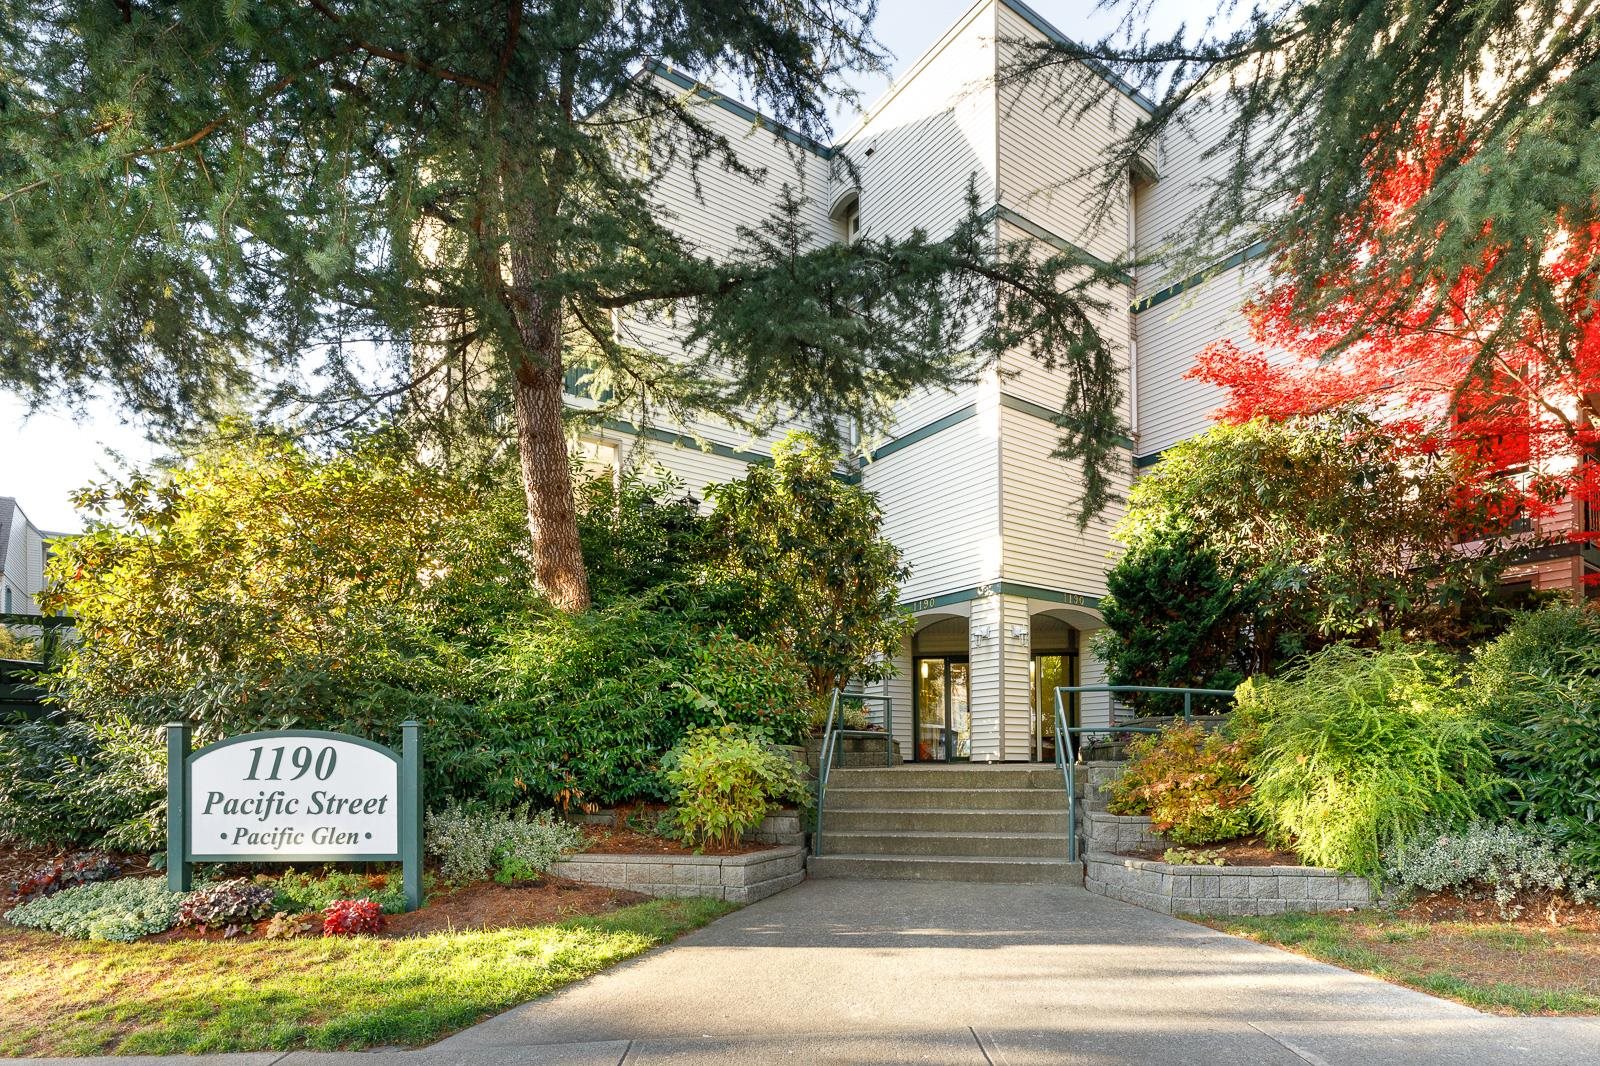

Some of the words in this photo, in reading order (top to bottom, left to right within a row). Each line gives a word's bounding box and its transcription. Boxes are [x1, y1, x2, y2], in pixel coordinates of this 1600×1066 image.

[913, 598, 935, 612] 1190
[242, 746, 337, 781] 1190
[201, 790, 299, 822] Pacific
[306, 790, 388, 815] Street
[232, 826, 304, 850] Pacific
[311, 826, 359, 845] Glen
